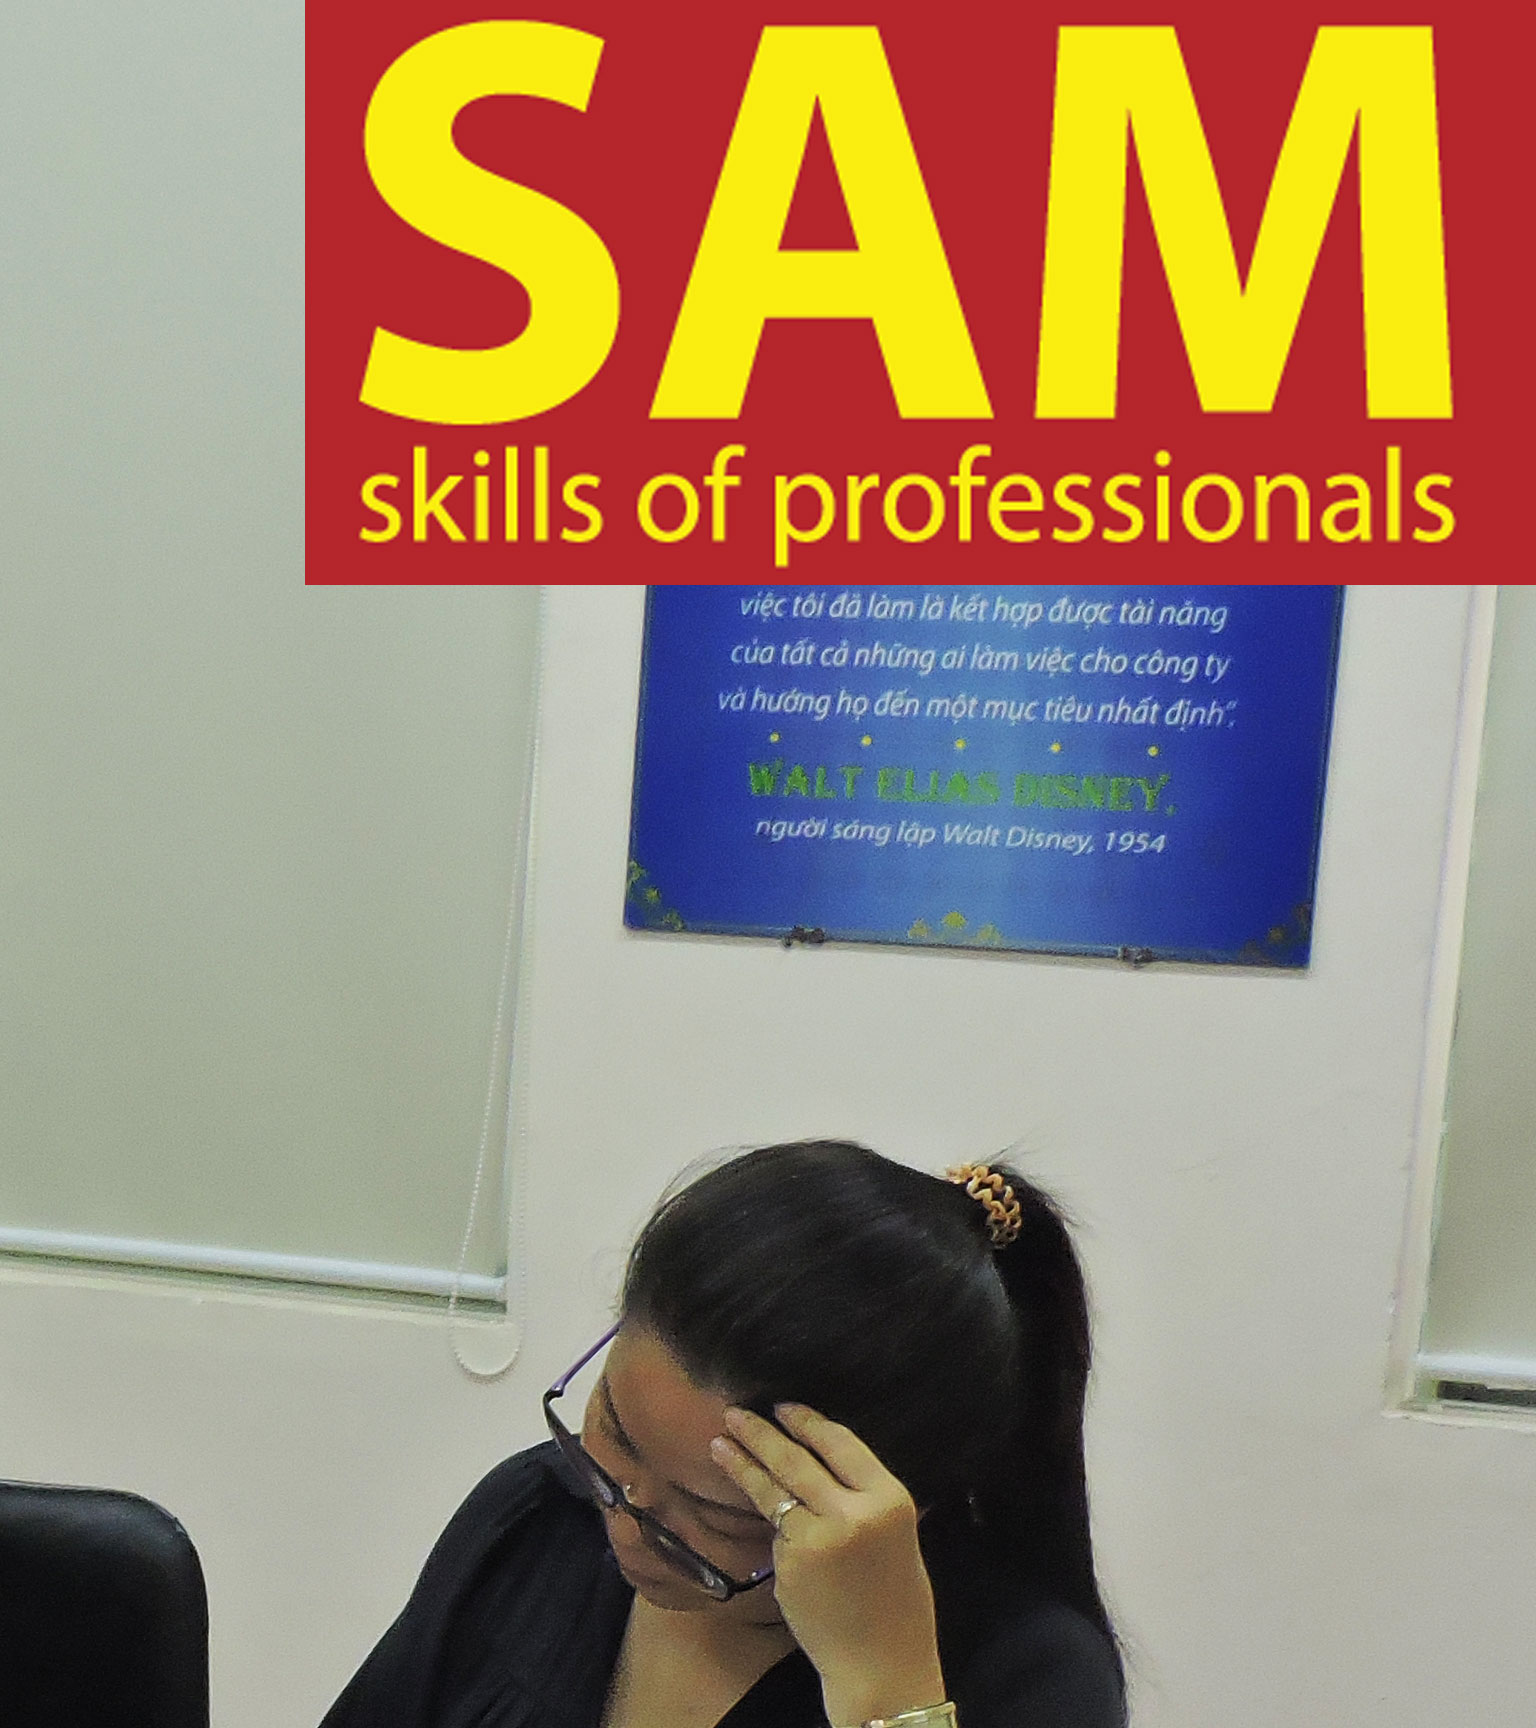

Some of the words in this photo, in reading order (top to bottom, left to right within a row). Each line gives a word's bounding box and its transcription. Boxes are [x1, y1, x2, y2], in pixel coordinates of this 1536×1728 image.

[740, 591, 786, 622] việc
[793, 591, 825, 618] tôi
[829, 592, 861, 618] đã
[867, 592, 914, 619] làm
[919, 593, 944, 620] là
[949, 591, 990, 621] kết
[992, 595, 1042, 628] hợp
[1048, 596, 1113, 631] được
[1119, 598, 1154, 624] tài
[731, 638, 774, 665] của
[781, 637, 815, 665] tất
[820, 640, 848, 667] cả
[854, 641, 936, 677] những
[941, 643, 966, 670] ai
[971, 644, 1019, 671] làm
[1026, 646, 1075, 678] việc
[1081, 647, 1128, 675] cho
[1133, 649, 1198, 683] công
[1205, 654, 1231, 683] ty
[719, 687, 746, 710] và
[751, 686, 831, 721] hướng
[837, 689, 869, 721] họ
[874, 688, 920, 717] đến
[927, 691, 978, 724] một
[983, 697, 1038, 726] mục
[1045, 696, 1093, 722] tiêu
[1097, 696, 1160, 724] nhất
[748, 759, 864, 799] WALT
[877, 764, 1001, 805] ELIAS
[755, 817, 827, 844] người
[831, 820, 898, 847] sáng
[897, 821, 935, 849] lập
[944, 822, 1000, 847] Walt
[1104, 829, 1166, 854] 1954
